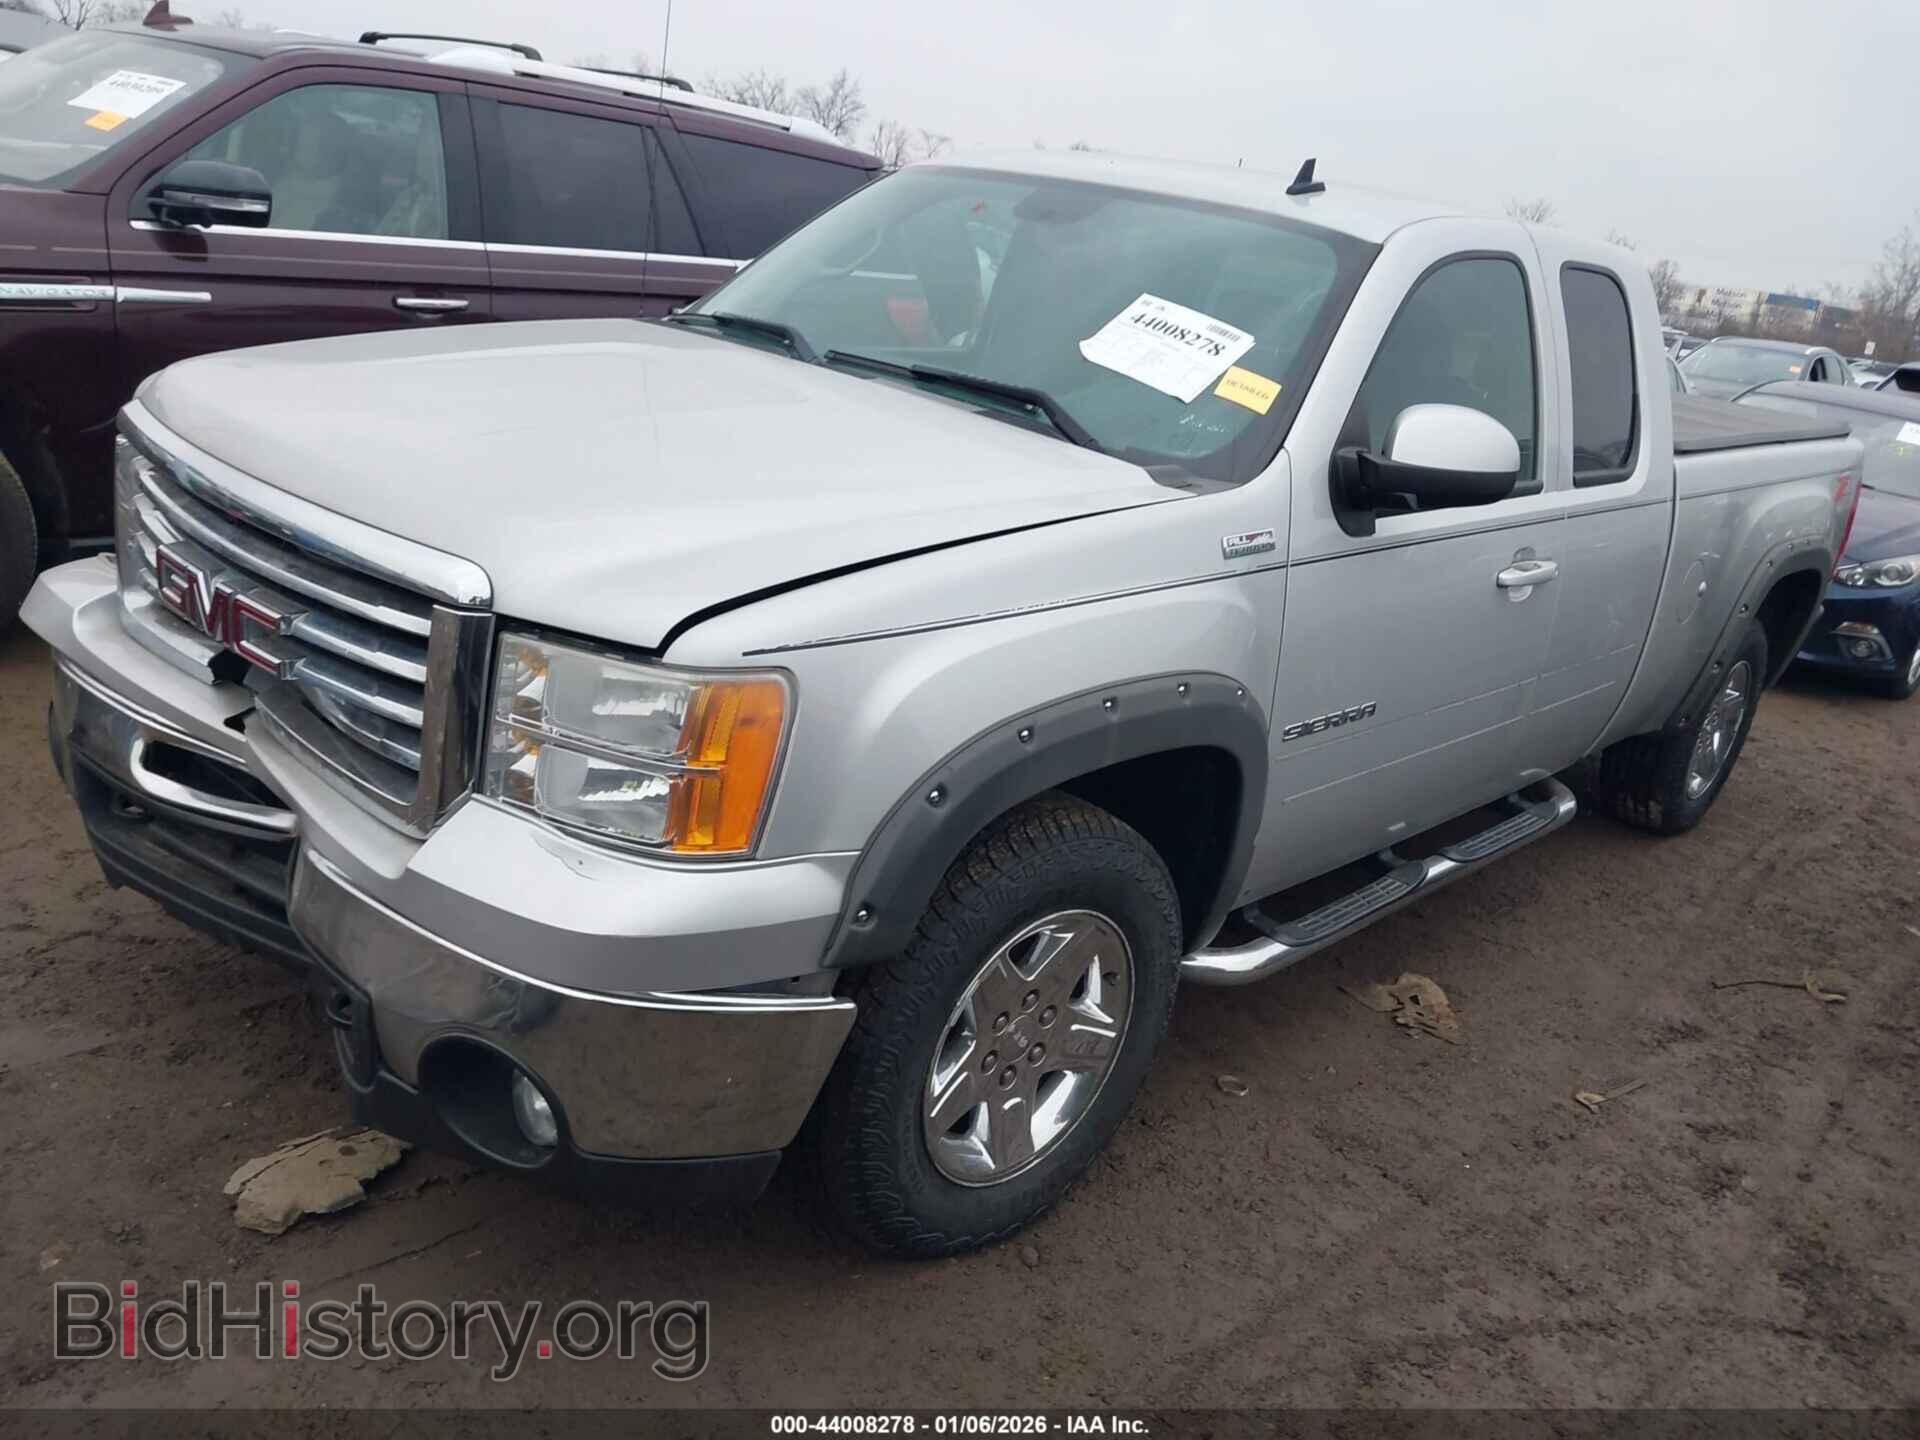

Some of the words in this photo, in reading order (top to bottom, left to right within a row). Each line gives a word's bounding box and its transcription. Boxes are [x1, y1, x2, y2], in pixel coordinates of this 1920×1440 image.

[1131, 313, 1226, 356] 44008278
[156, 544, 294, 680] GMC
[1282, 701, 1377, 742] SIERRA
